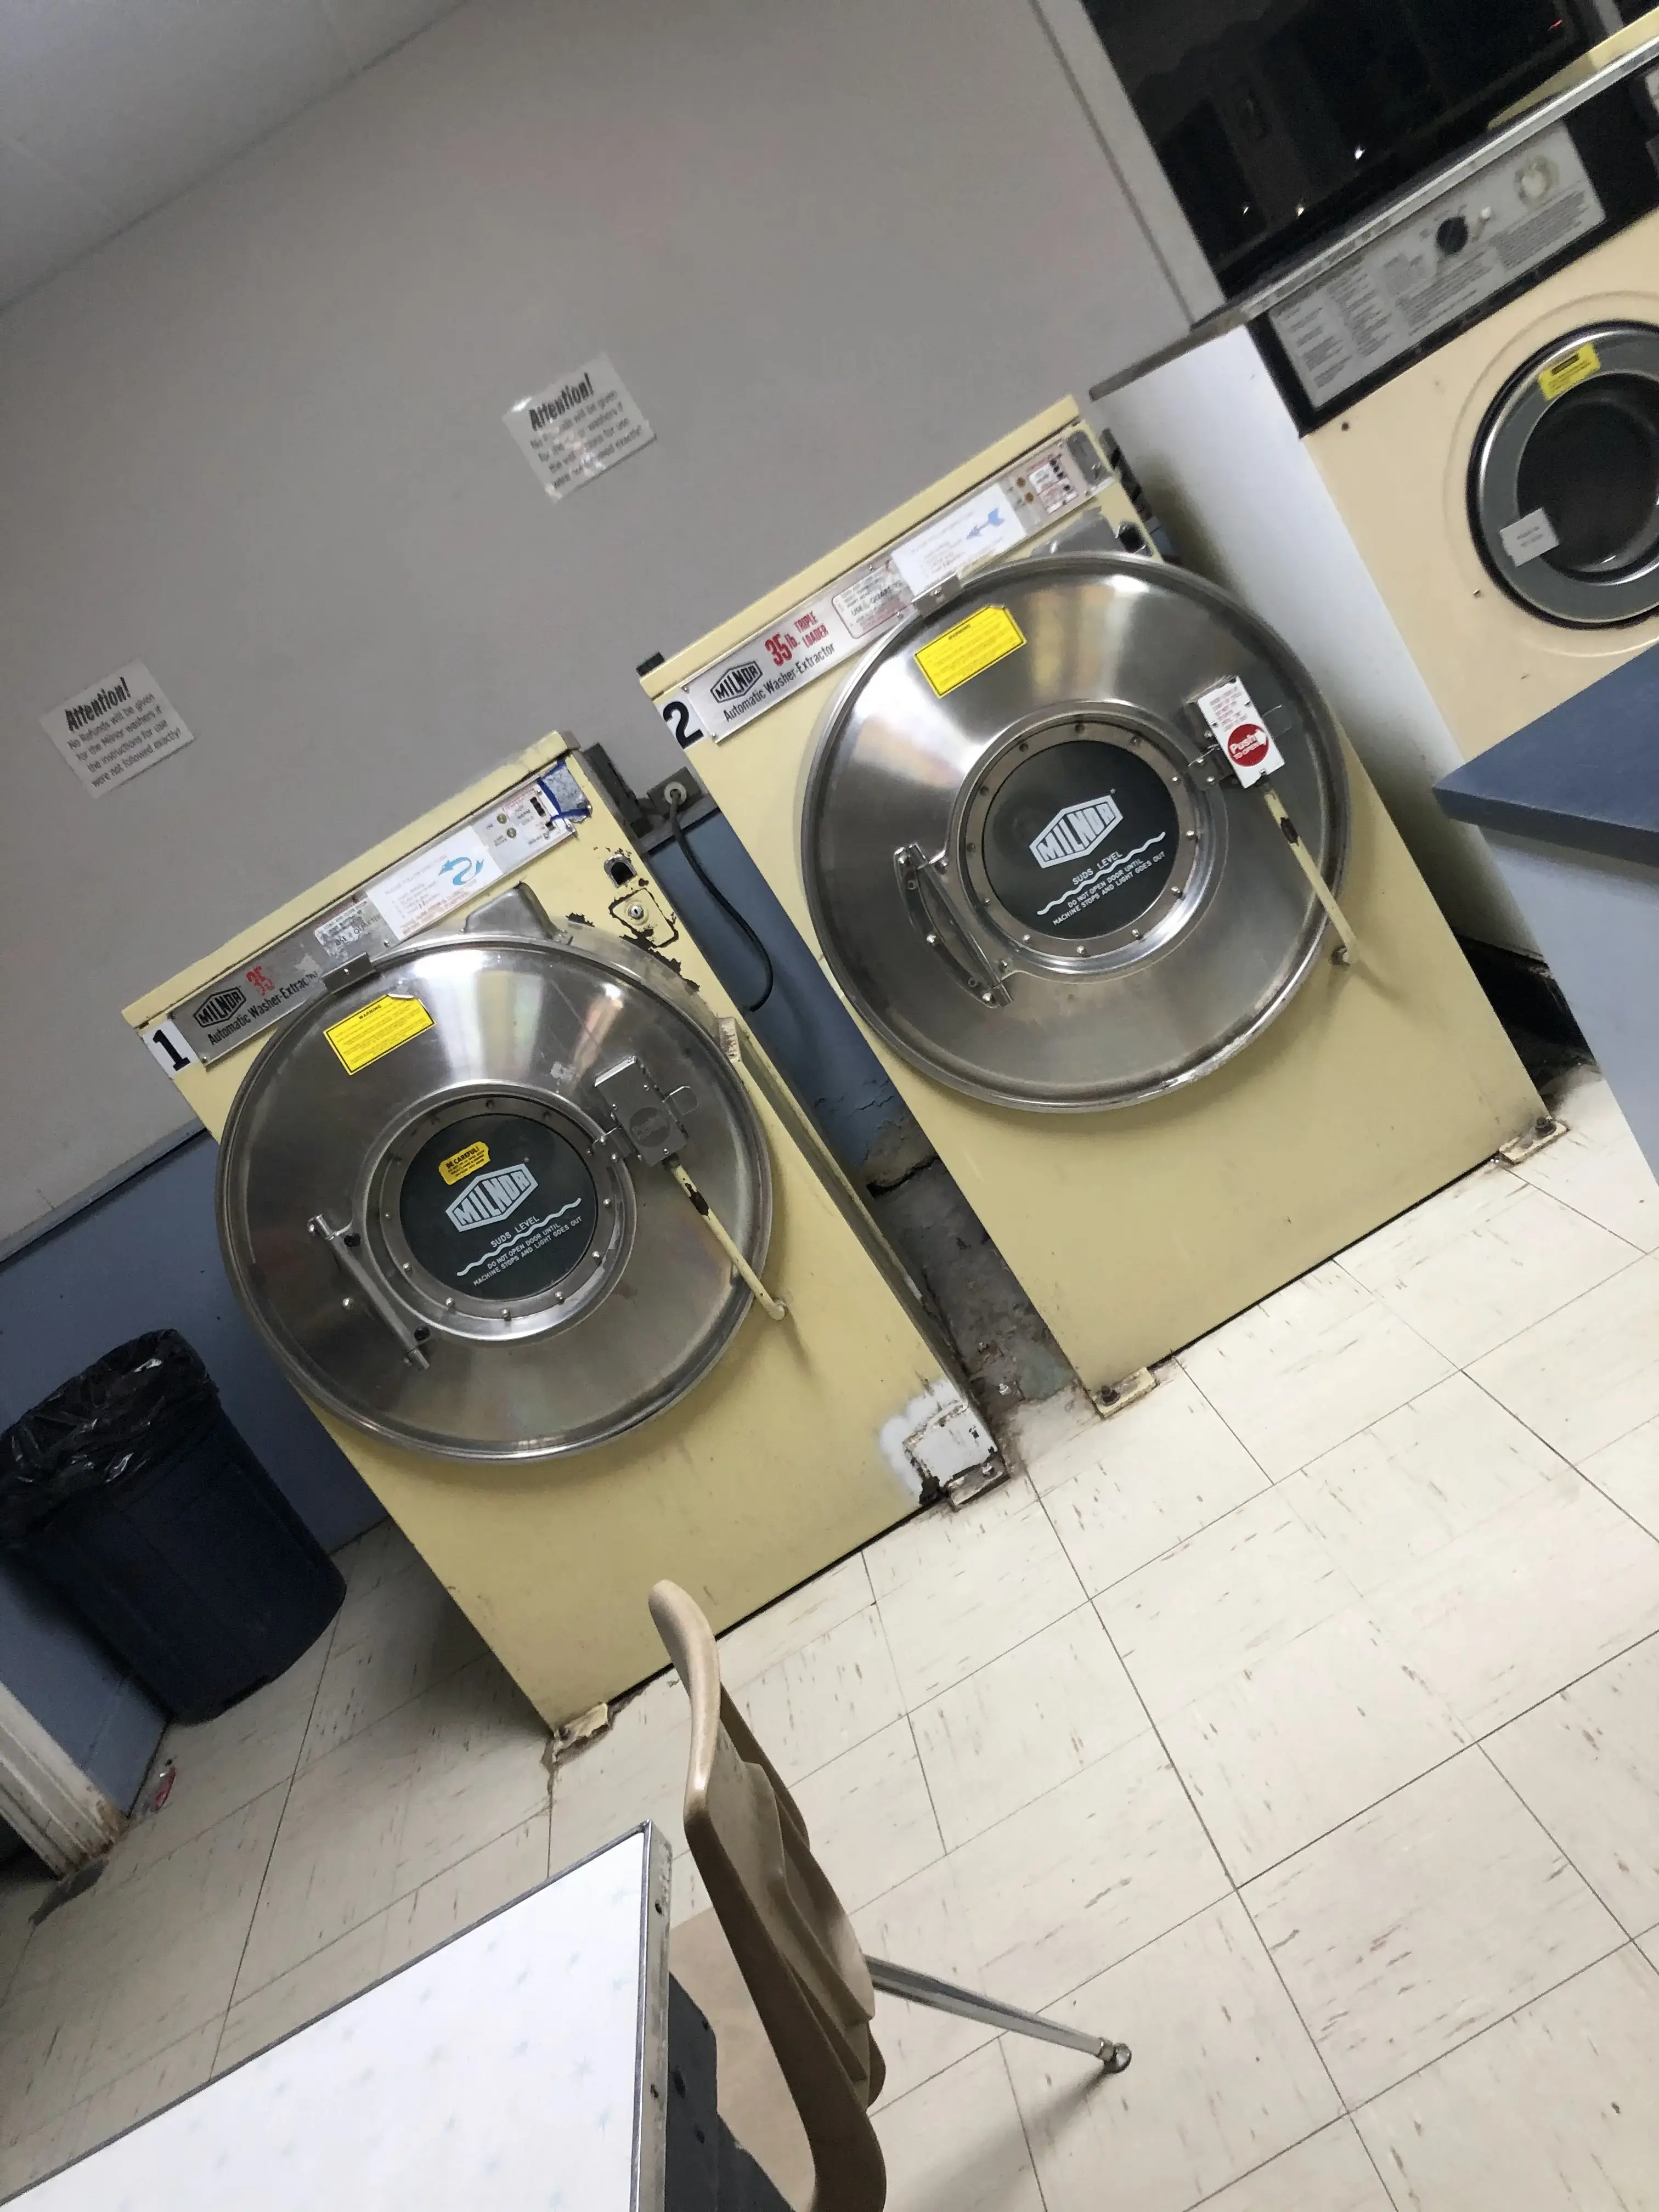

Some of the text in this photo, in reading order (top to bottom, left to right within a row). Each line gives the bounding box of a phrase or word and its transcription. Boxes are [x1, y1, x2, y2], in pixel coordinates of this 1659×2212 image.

[528, 374, 595, 431] Attention!
[794, 611, 818, 632] TRIPLE
[802, 625, 828, 648] LOADER
[765, 633, 799, 666] 35 lb.
[714, 663, 760, 701] MILNOR
[64, 676, 132, 731] Attention!
[67, 693, 155, 750] No Refunds will be given
[662, 699, 703, 749] 2
[723, 689, 766, 721] Automatic
[76, 752, 88, 761] for
[88, 743, 101, 754] the
[101, 729, 125, 746] Milnor
[125, 710, 156, 732] washers
[87, 719, 167, 773] the instructions for use
[1229, 733, 1257, 754] Push
[91, 772, 111, 788] were
[110, 763, 123, 776] not
[1036, 802, 1115, 862] MILNOR
[1053, 851, 1165, 926] MACHINE STOPS AND LIGHT GOES OUT
[1067, 859, 1143, 908] DO NOT OPEN DOOR UNTIL
[1072, 851, 1123, 885] SUDS LEVEL
[197, 990, 242, 1025] MILNOR
[359, 1005, 382, 1020] WARNING
[152, 1028, 190, 1072] 1
[207, 1013, 251, 1046] Automatic
[453, 1146, 479, 1164] CAREFUL!
[454, 1170, 531, 1225] MILNOR
[473, 1216, 582, 1286] MACHINE STOPS AND LIGHT GOES OUT
[487, 1223, 561, 1269] DO NOT OPEN DOOR UNTIL
[490, 1215, 540, 1248] SUDS LEVEL
